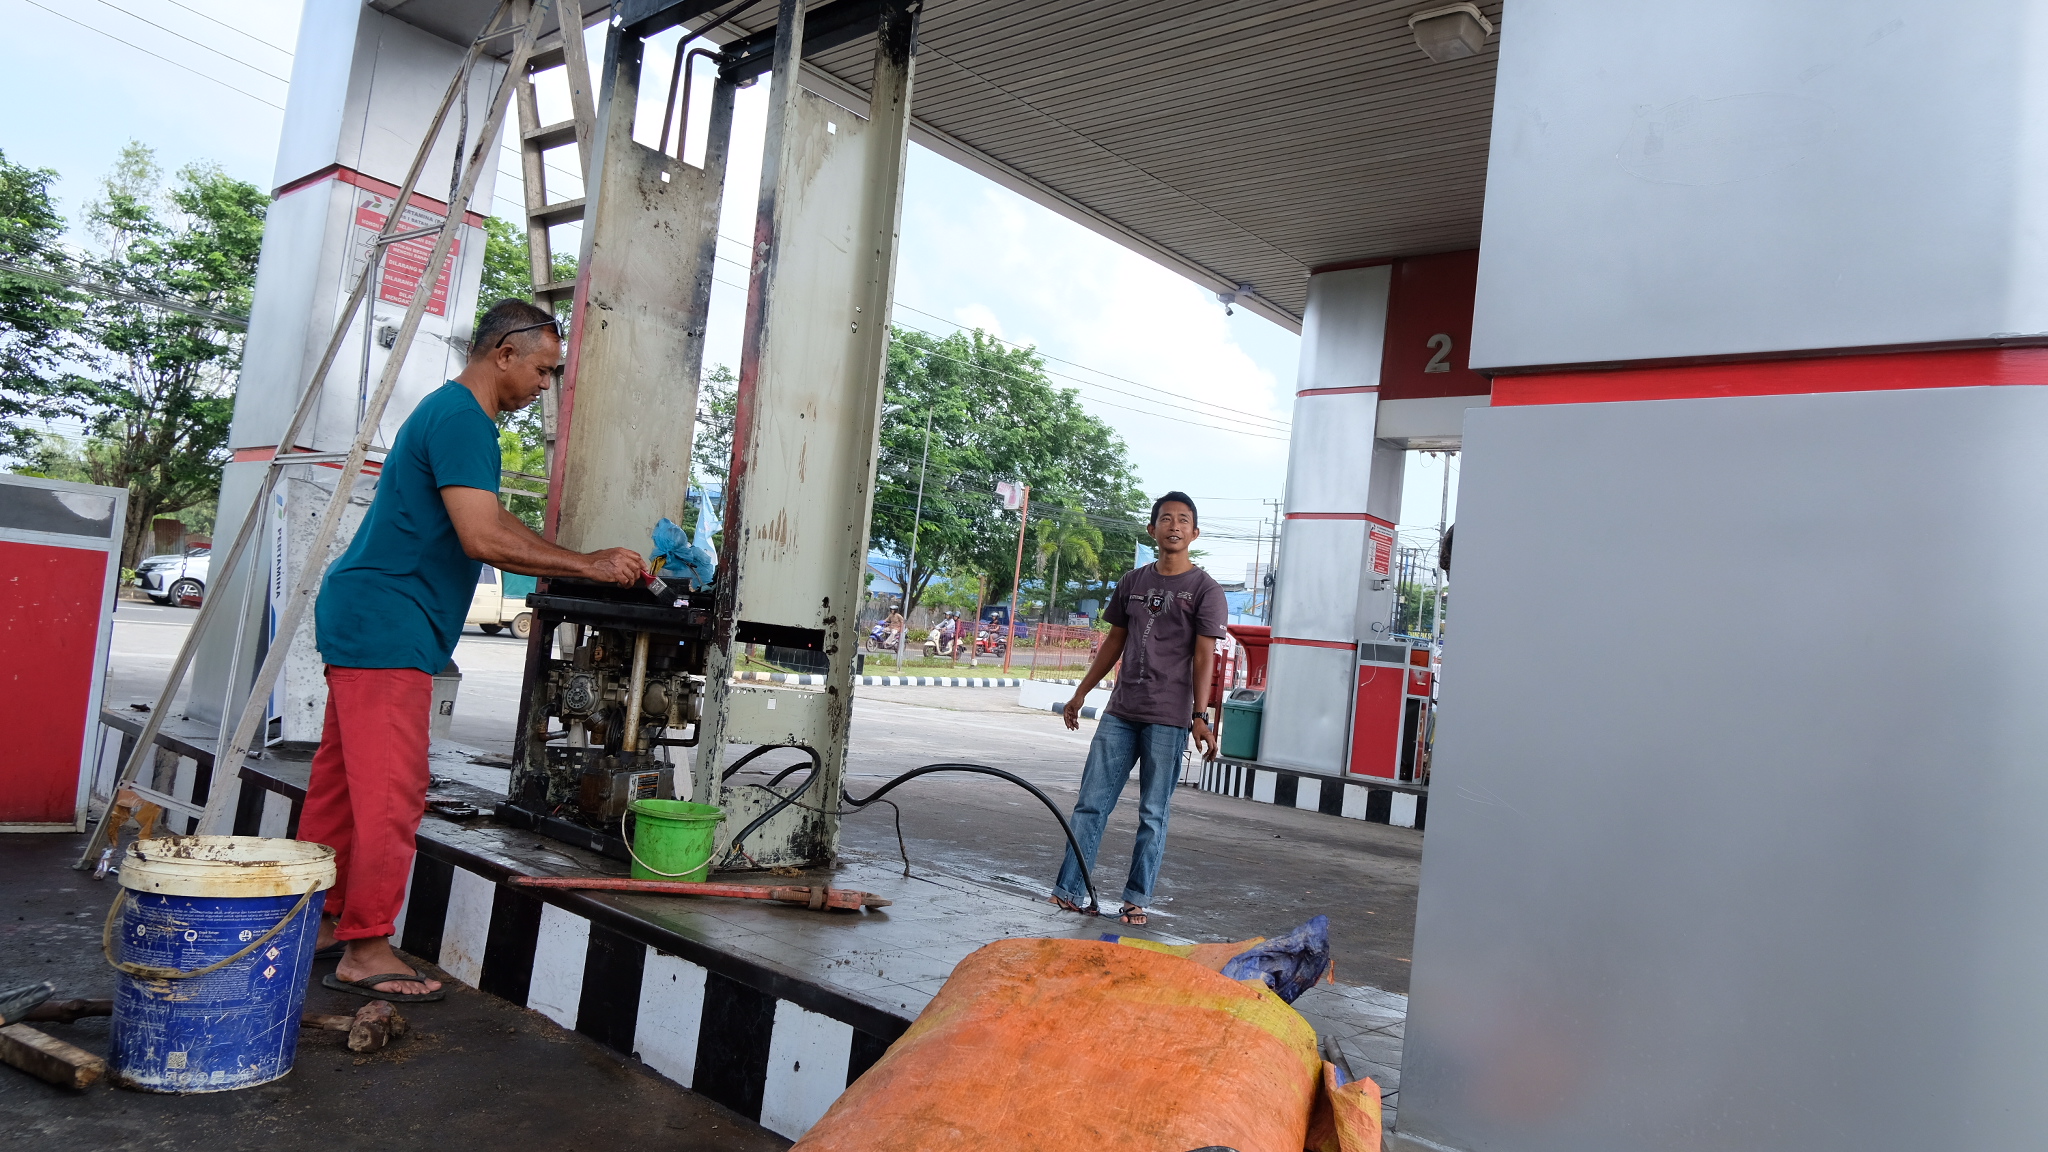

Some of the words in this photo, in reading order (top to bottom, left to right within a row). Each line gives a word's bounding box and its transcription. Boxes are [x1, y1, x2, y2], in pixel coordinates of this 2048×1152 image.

[388, 259, 418, 272] DILARANG
[384, 274, 414, 286] DILARANG
[1424, 333, 1452, 373] 2
[275, 527, 283, 600] PERTAMINA
